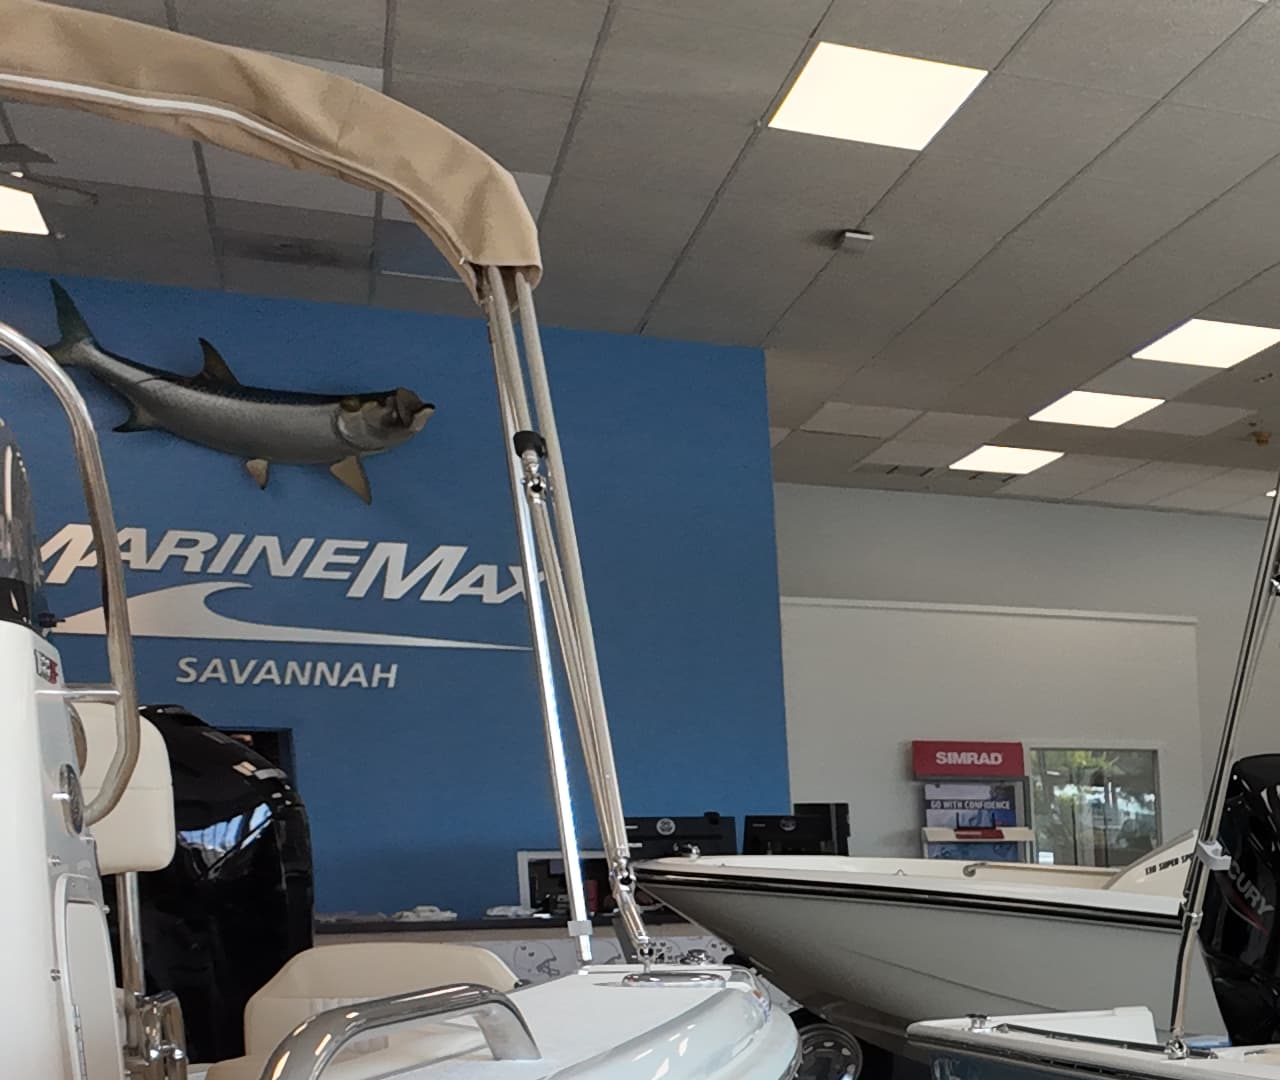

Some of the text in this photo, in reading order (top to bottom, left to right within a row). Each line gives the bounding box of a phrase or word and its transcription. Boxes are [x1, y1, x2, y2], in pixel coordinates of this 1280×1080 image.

[176, 656, 398, 690] SAVANNAH
[936, 751, 1002, 765] SIMRAD
[930, 801, 1010, 810] GO WITH CONFIDENCE
[1227, 859, 1275, 916] CURY
